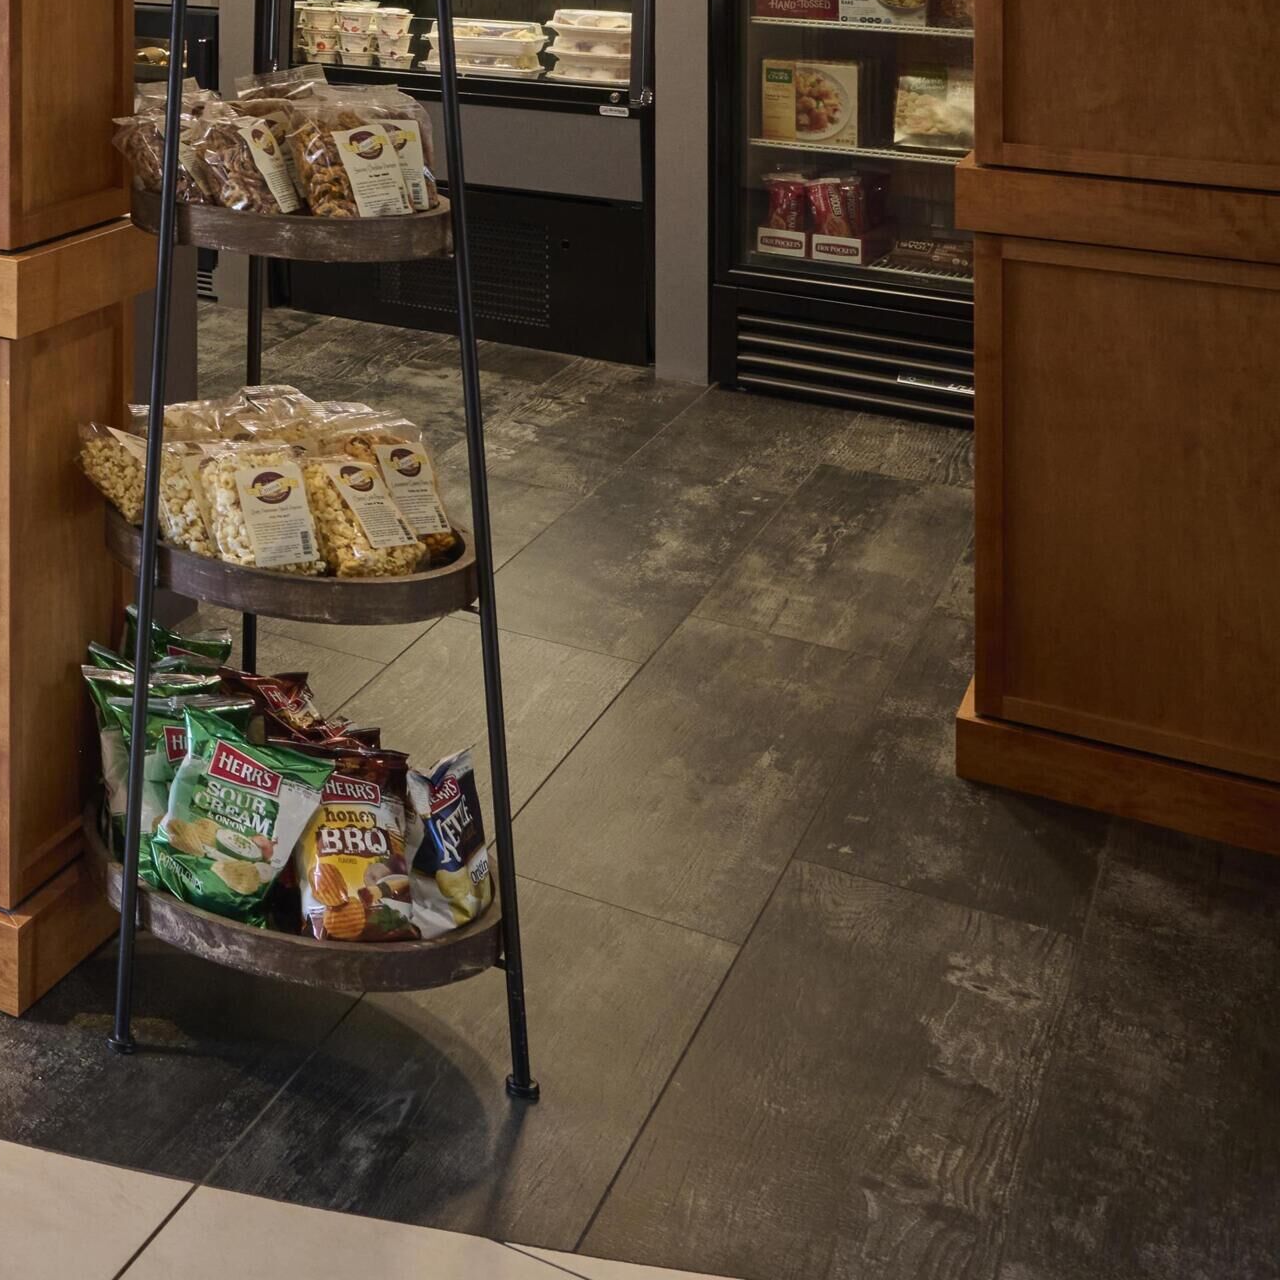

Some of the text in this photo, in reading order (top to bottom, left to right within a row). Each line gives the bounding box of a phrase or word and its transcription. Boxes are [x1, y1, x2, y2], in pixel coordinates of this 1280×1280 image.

[218, 750, 273, 789] HERR'S
[207, 780, 267, 815] SOUR
[325, 780, 376, 801] HERR'S
[193, 790, 275, 836] CREAM
[214, 812, 248, 833] ONION
[324, 807, 377, 828] honey
[320, 827, 390, 858] BBQ
[470, 859, 489, 886] Origin
